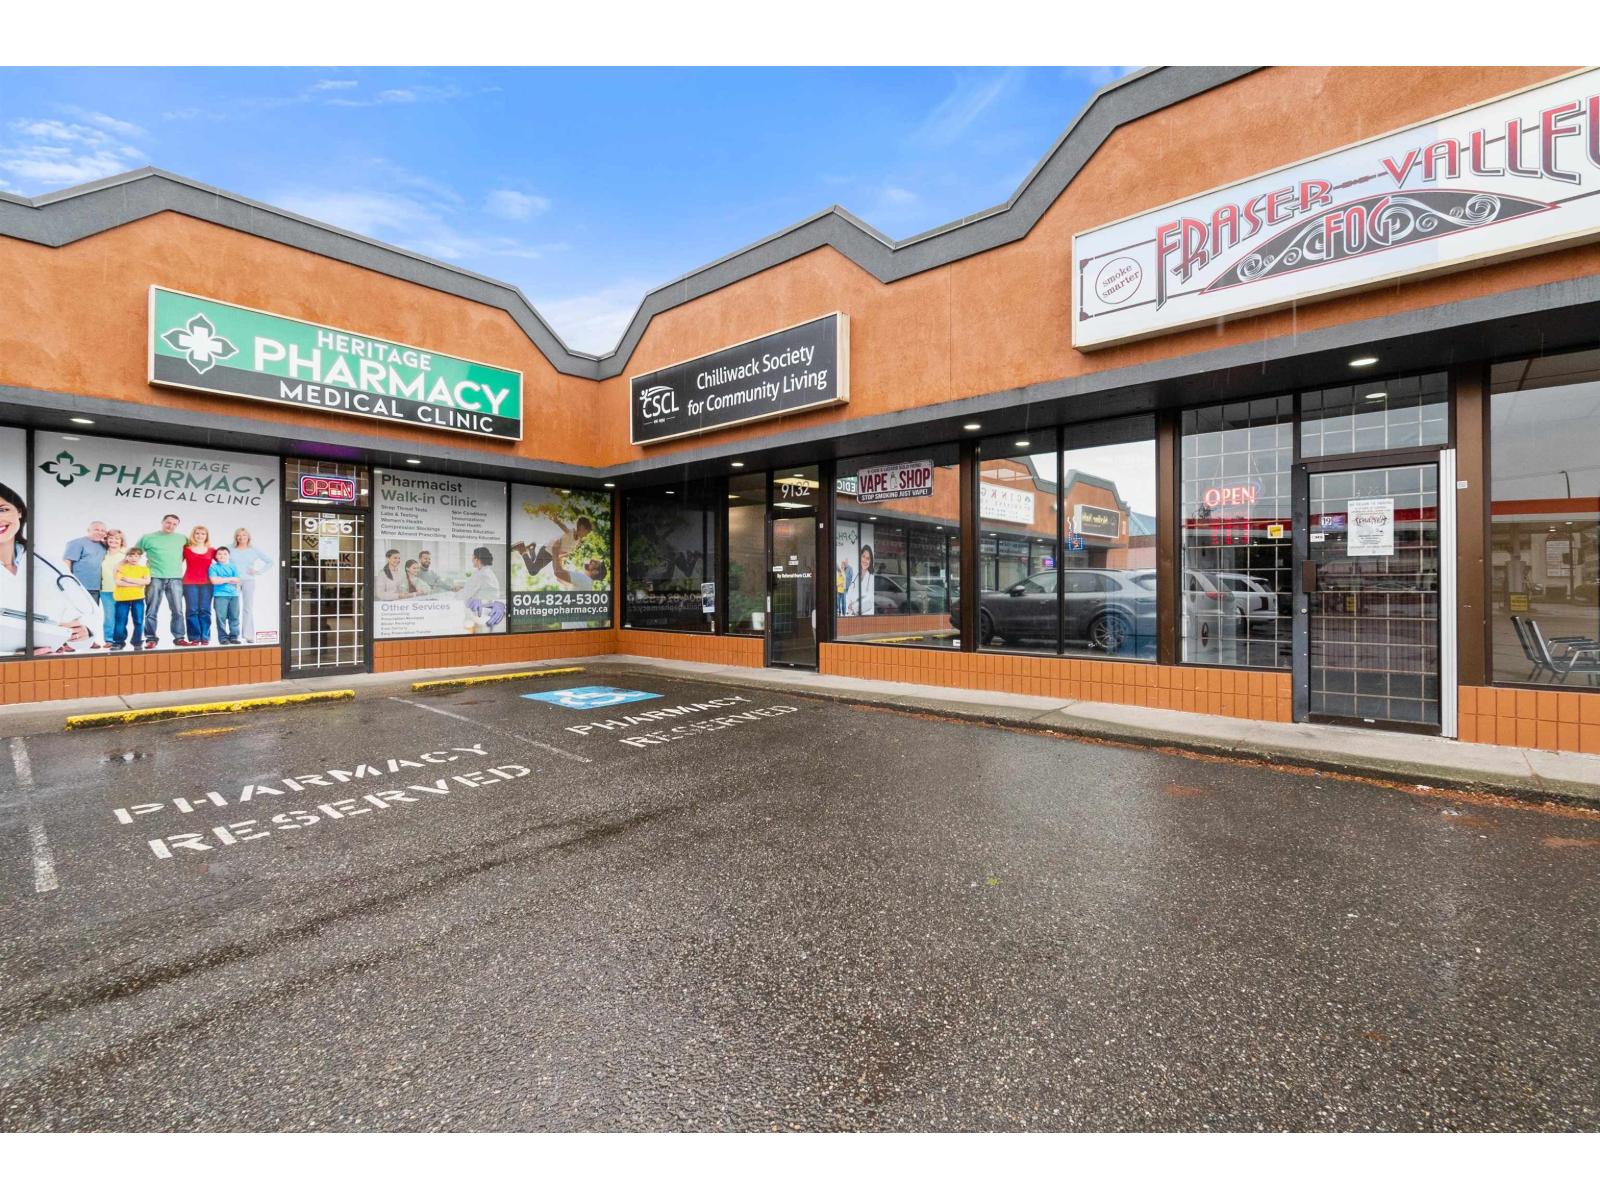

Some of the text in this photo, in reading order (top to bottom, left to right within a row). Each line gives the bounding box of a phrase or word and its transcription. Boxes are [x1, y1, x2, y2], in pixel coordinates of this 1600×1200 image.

[1323, 196, 1392, 260] FOG
[1156, 180, 1333, 312] FRASER
[1102, 271, 1139, 298] smarter
[1103, 265, 1132, 287] smoke
[318, 330, 432, 371] HERITAGE
[254, 336, 510, 416] PHARMACY
[697, 345, 815, 390] Chilliwack Society
[280, 380, 494, 432] MEDICAL CLINIC
[642, 391, 680, 418] CSCL
[687, 369, 828, 417] for Community Living
[152, 456, 231, 474] HERITAGE
[94, 463, 276, 495] PHARMACY
[302, 478, 353, 499] OPEN
[381, 474, 463, 493] Pharmacist
[781, 481, 811, 499] 9132
[860, 473, 888, 493] VAPE
[899, 467, 931, 489] SHOP
[115, 487, 262, 507] MEDICAL CLINIC
[381, 489, 478, 508] Walk-in Clinic
[861, 493, 875, 501] STOP
[1205, 486, 1256, 507] OPEN
[304, 517, 353, 535] 9136
[381, 602, 451, 612] Other Services
[512, 593, 609, 606] 604-824-5300
[512, 606, 608, 617] heritagepharmacy.ca
[565, 695, 751, 735] PHARMACY
[619, 705, 798, 748] RESERVED
[113, 743, 488, 825] PHARMACY
[148, 764, 531, 860] RESERVED
